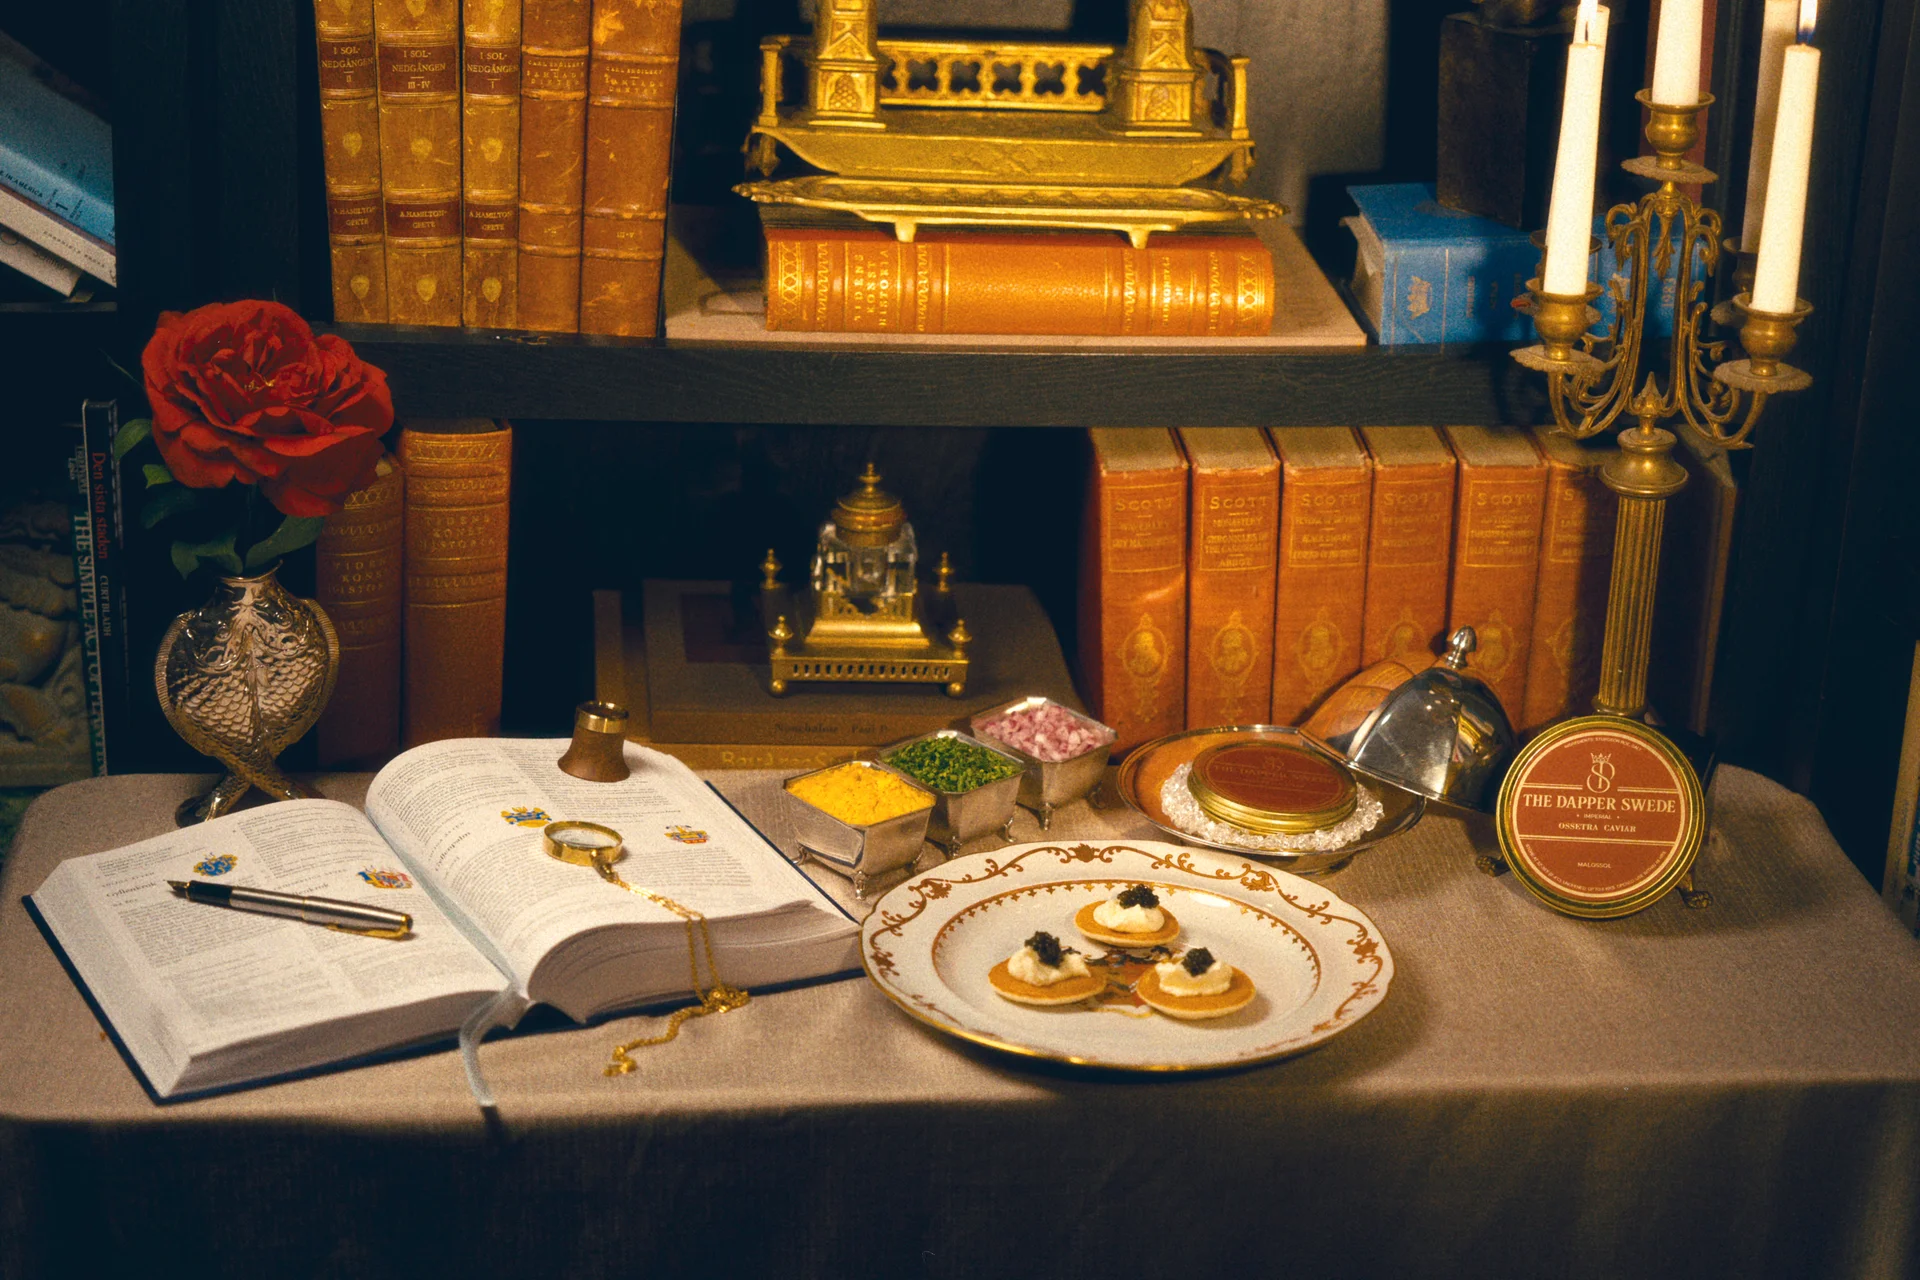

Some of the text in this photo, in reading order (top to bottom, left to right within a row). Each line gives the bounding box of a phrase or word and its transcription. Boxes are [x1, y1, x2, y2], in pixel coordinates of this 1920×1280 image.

[410, 50, 432, 58] SOL-
[486, 52, 508, 60] SOL-
[321, 57, 374, 69] NEDGÅNGEN
[392, 63, 446, 73] NEDGÅNGEN
[467, 63, 519, 73] NEDGÅNGEN
[14, 178, 43, 198] AMERICA
[853, 254, 864, 321] TIDENS
[866, 260, 877, 313] KONST
[879, 249, 889, 326] HISTORIA
[1116, 497, 1174, 511] SCOTT
[1209, 496, 1268, 510] SCOTT
[1301, 493, 1360, 507] SCOTT
[1384, 491, 1441, 505] SCOTT
[1477, 493, 1536, 505] SCOTT
[92, 452, 112, 559] Den sista staden
[74, 511, 93, 552] THE
[77, 555, 97, 620] SIMPLE
[99, 575, 112, 637] CURT BLADH
[84, 623, 98, 657] ACT
[1523, 793, 1677, 813] THE DAPPER SWEDE
[1558, 822, 1637, 833] OSSETRA CAVIAR
